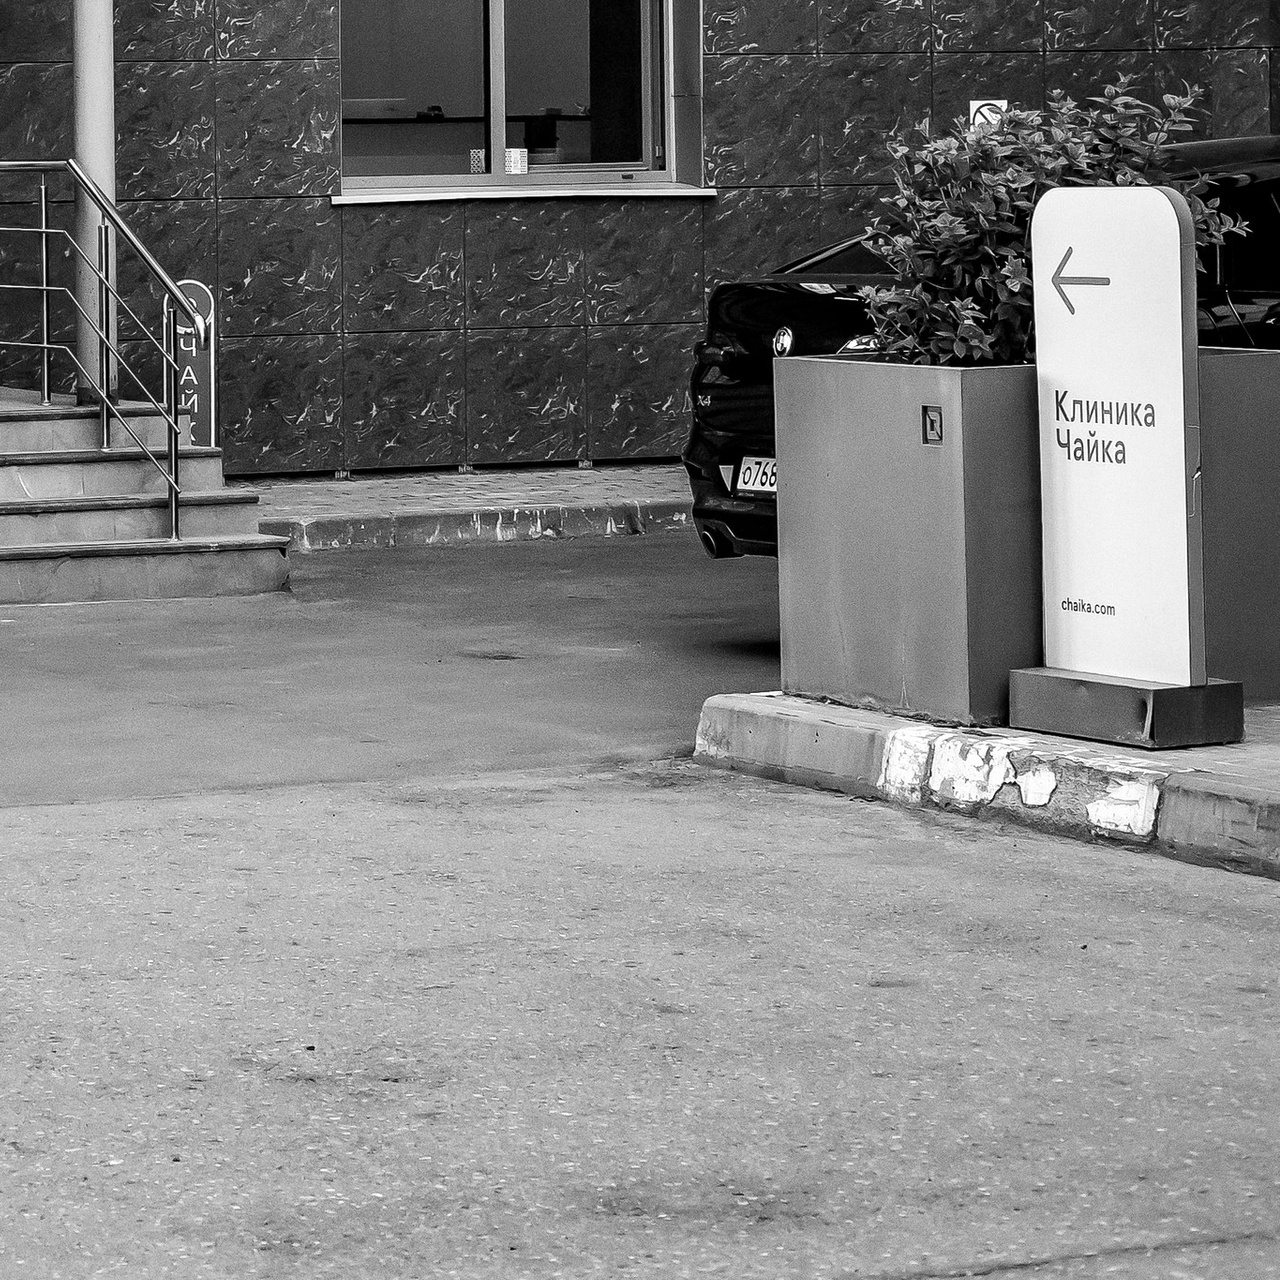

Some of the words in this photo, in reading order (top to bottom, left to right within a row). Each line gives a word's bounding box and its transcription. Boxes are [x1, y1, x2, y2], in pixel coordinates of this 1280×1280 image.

[1054, 389, 1157, 428] Клиника
[1055, 428, 1127, 465] Чайка
[1061, 597, 1116, 617] chaika.com
